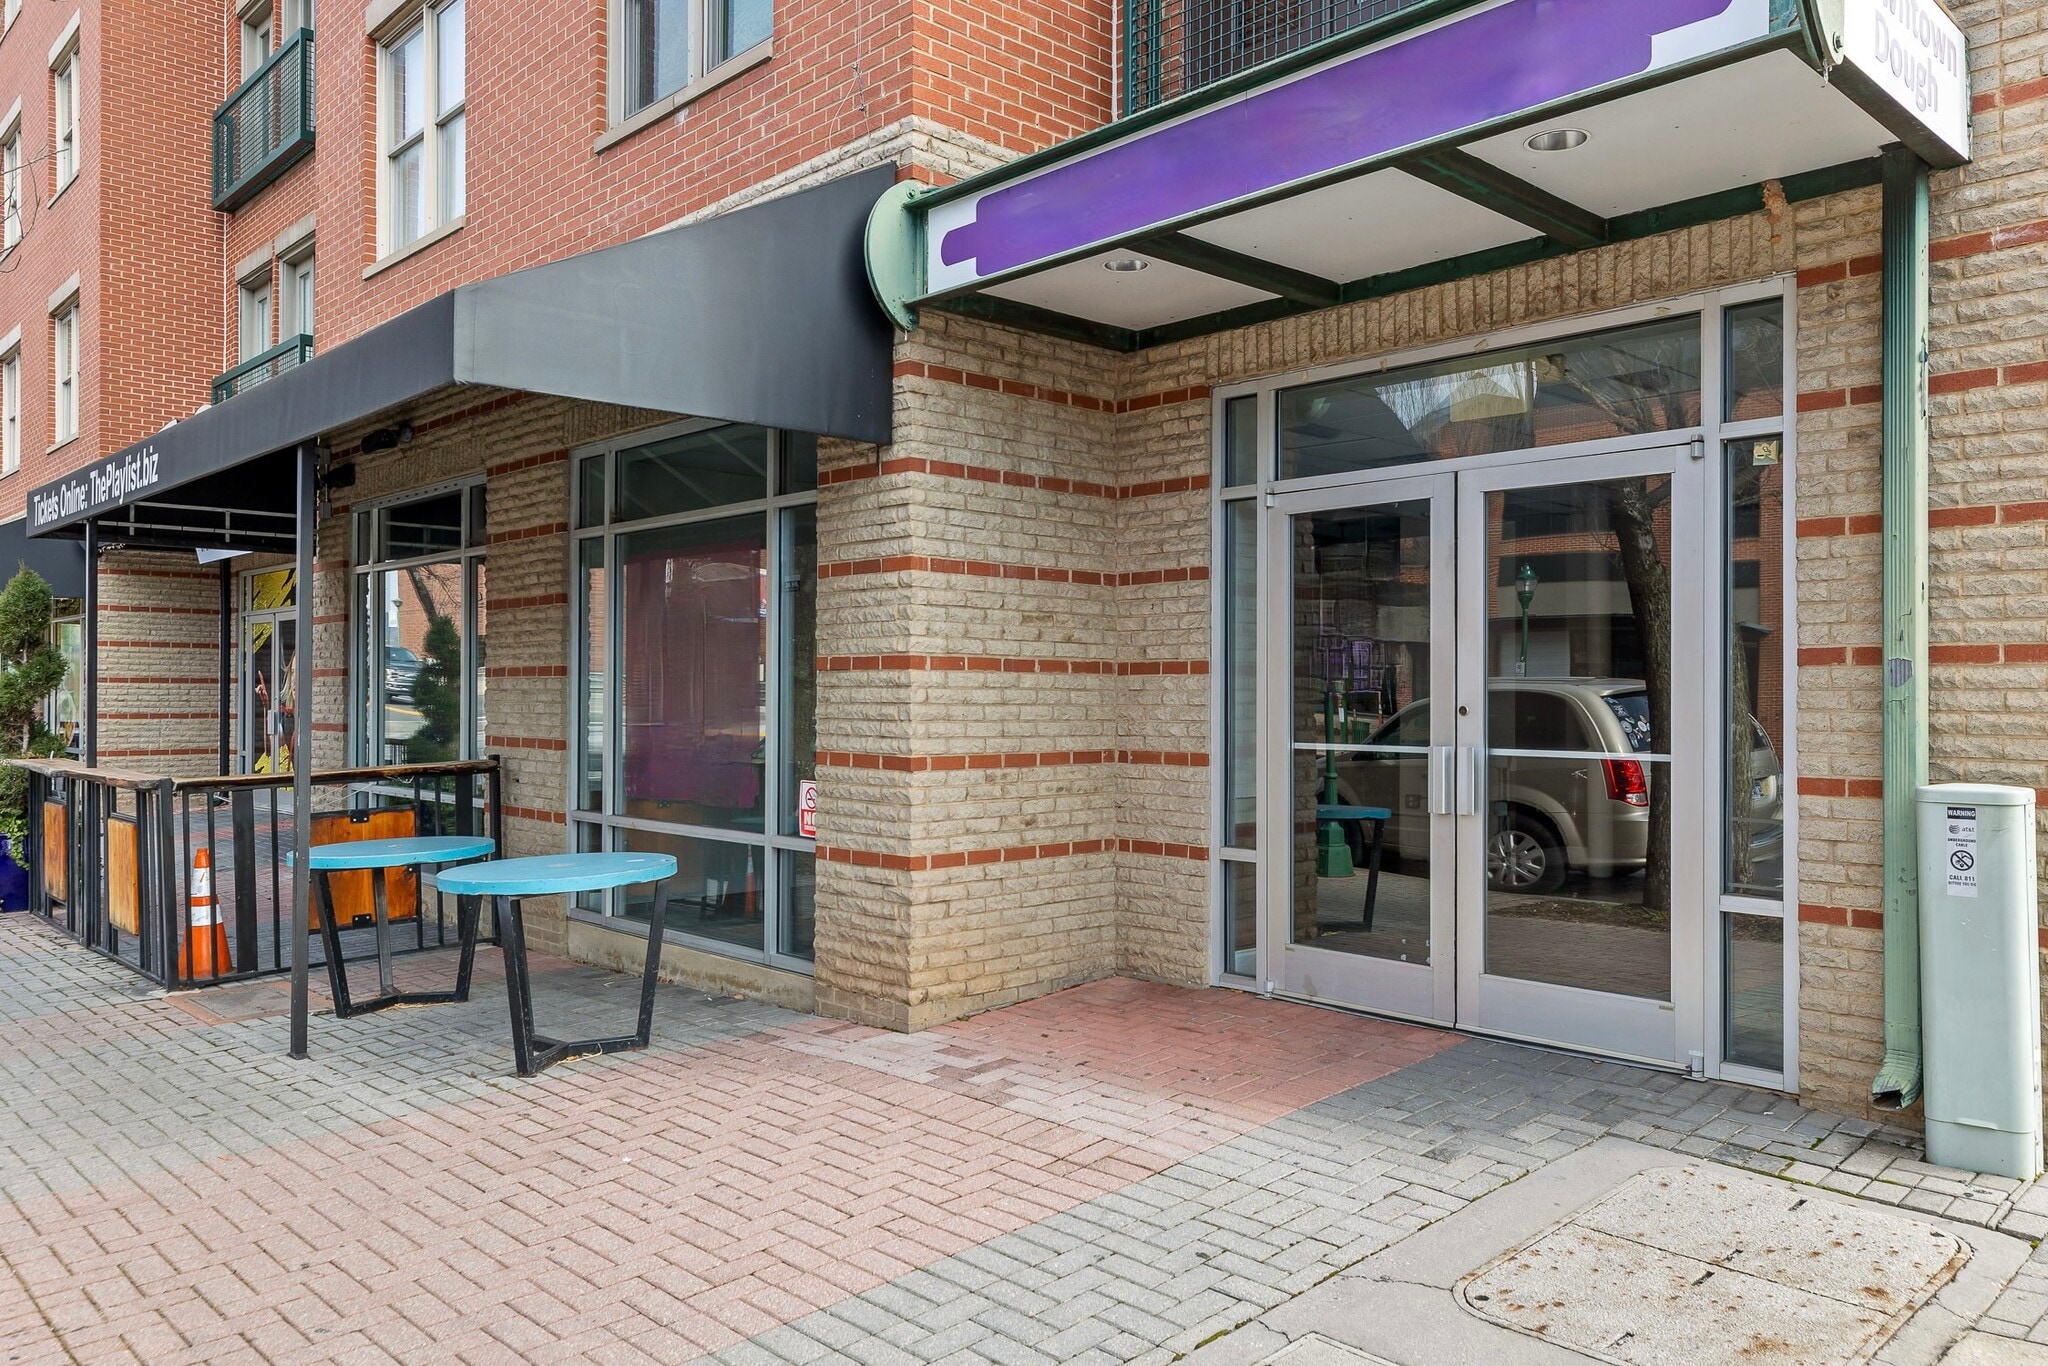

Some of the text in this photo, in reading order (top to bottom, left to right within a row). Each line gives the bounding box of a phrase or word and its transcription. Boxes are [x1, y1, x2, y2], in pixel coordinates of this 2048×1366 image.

[1875, 9, 1938, 112] Dough
[33, 445, 159, 527] Tickets Online: ThePlaylist.biz
